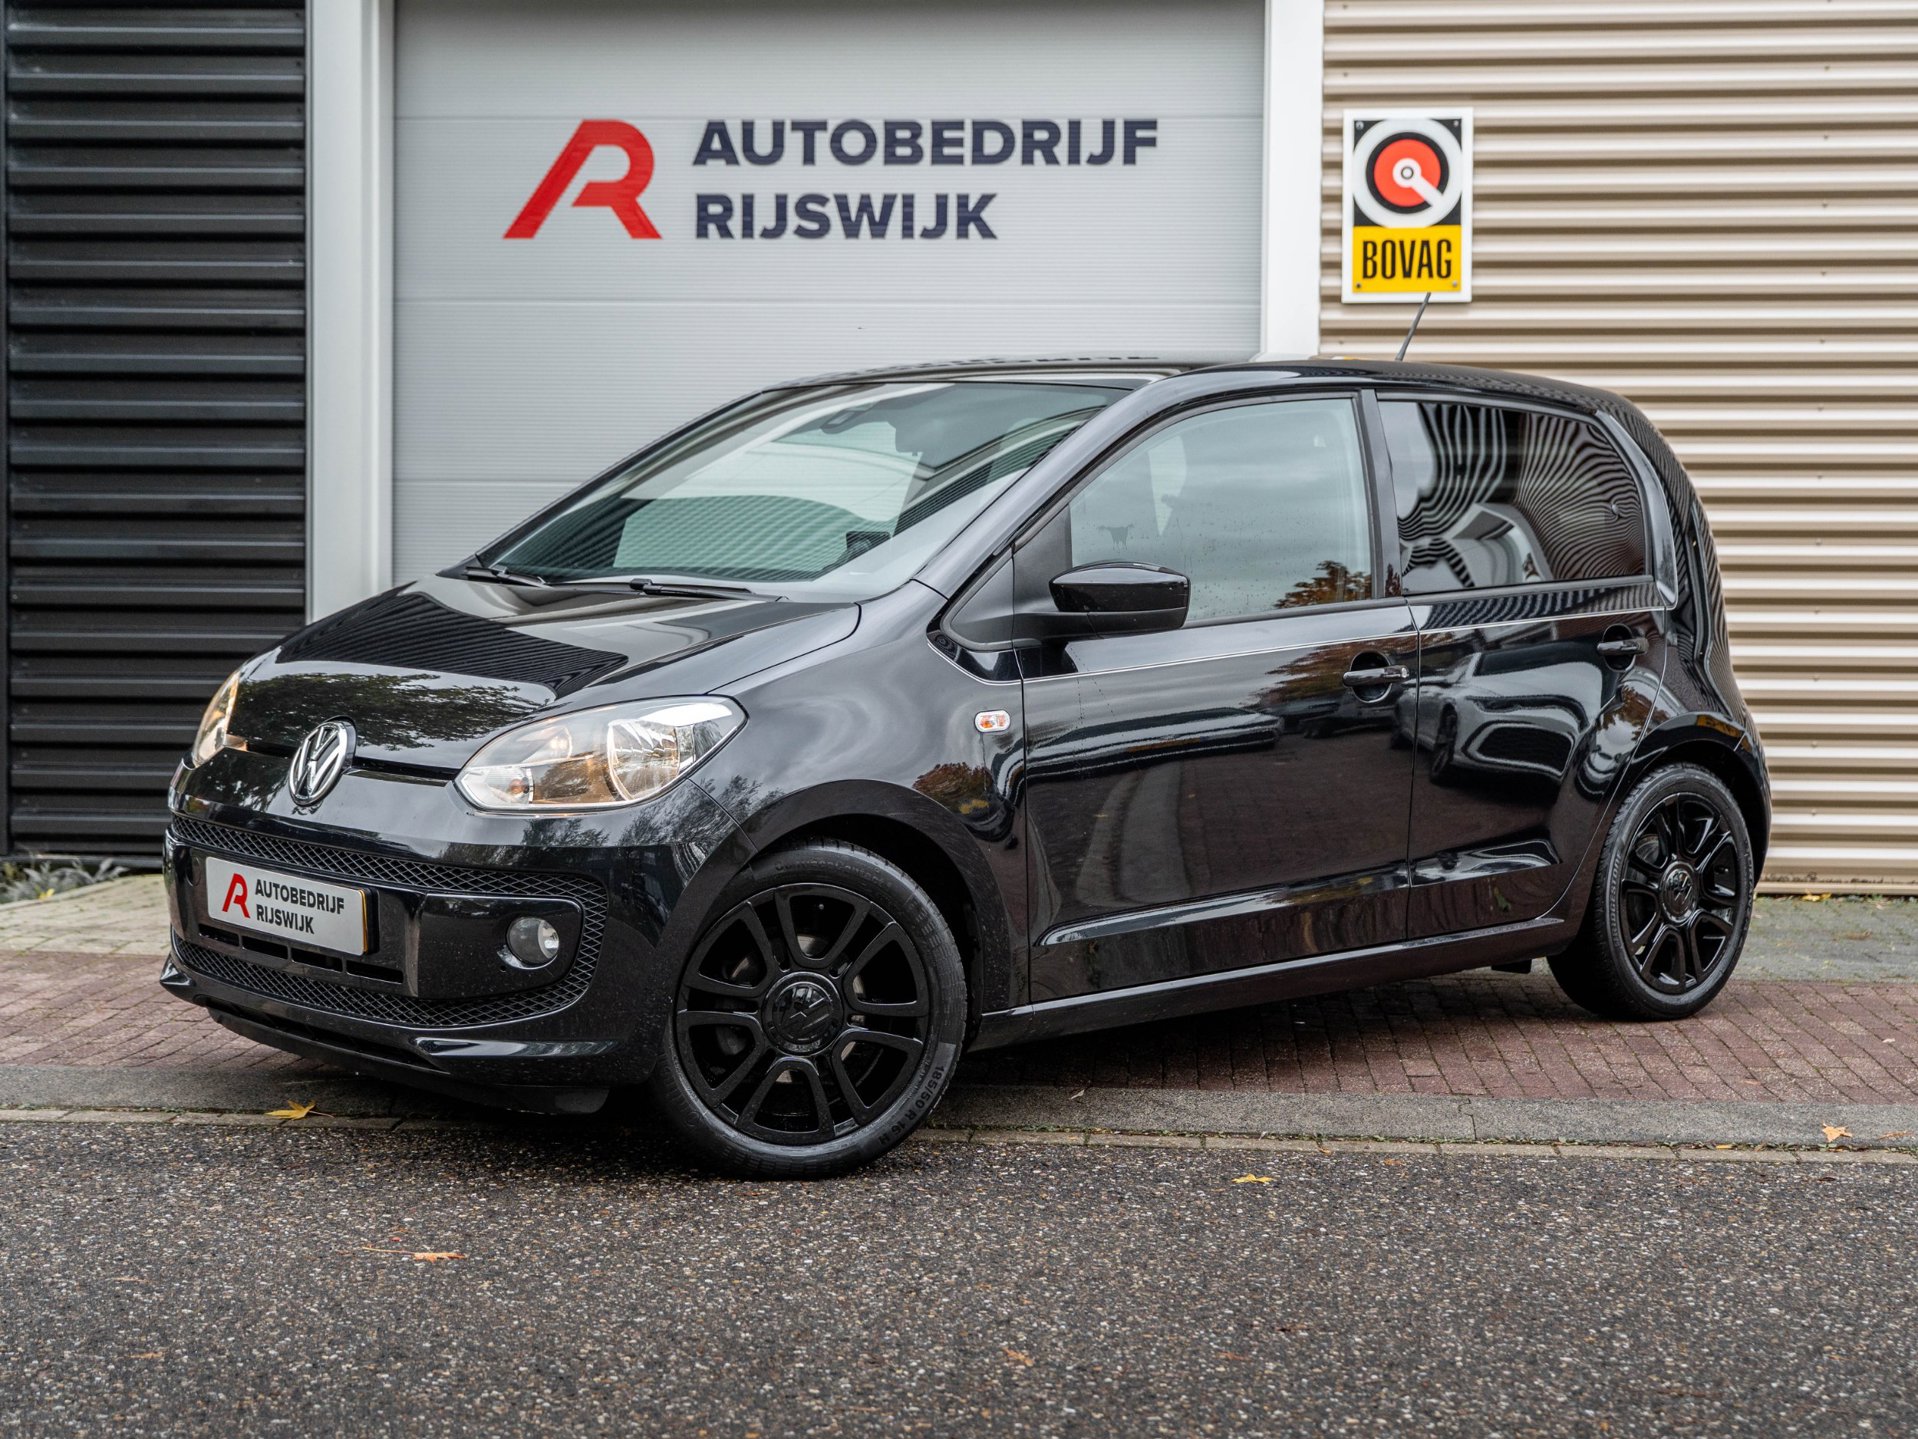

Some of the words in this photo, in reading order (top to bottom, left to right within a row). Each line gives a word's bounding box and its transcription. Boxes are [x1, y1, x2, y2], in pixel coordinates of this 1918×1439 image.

[692, 118, 1158, 166] AUTOBEDRIJF
[694, 192, 997, 240] RIJSWIJK
[1362, 238, 1452, 280] BOVAG
[254, 878, 345, 915] AUTOBEDRIJF
[256, 903, 315, 935] RIJSWIJK
[914, 1065, 945, 1109] 185/50
[891, 1120, 906, 1135] 16
[904, 1109, 918, 1121] R
